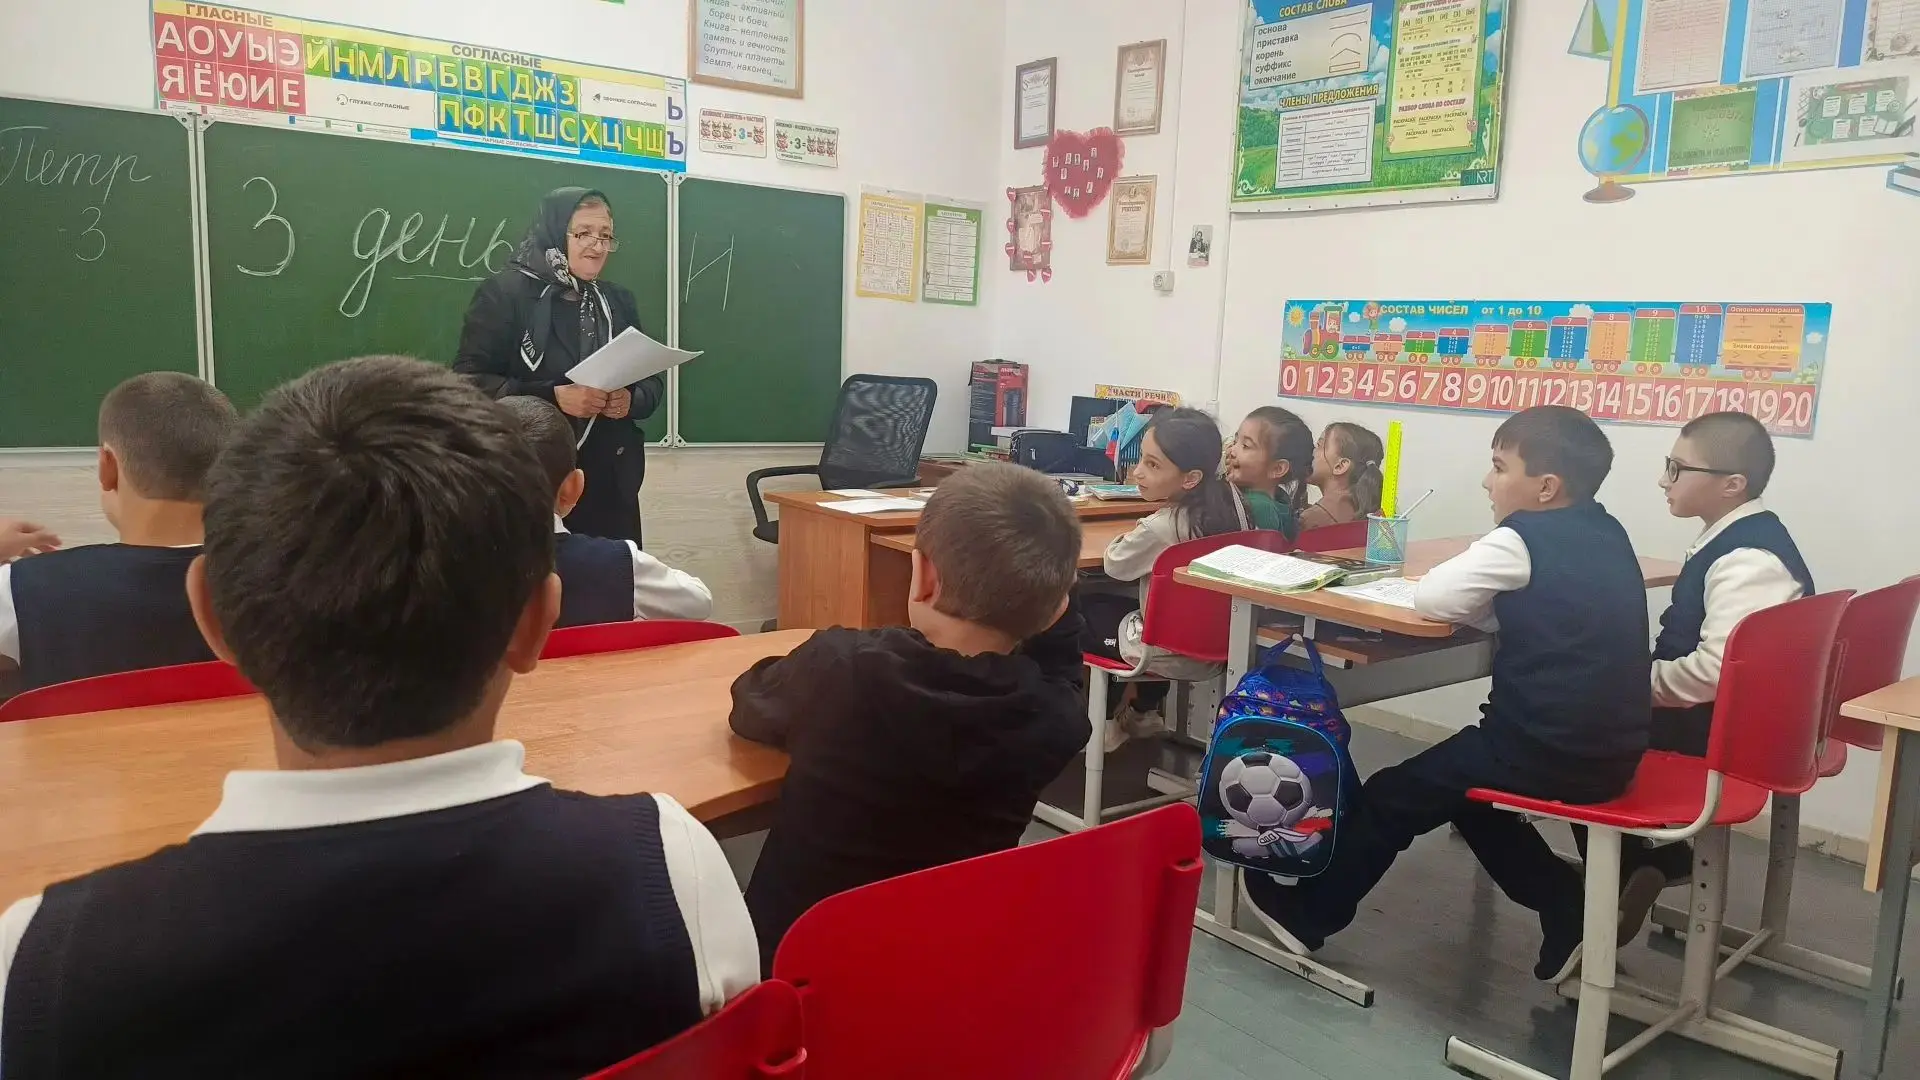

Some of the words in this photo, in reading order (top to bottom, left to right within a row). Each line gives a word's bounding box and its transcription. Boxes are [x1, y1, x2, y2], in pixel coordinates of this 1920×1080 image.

[185, 3, 273, 28] ГЛАСНЫЕ
[709, 8, 736, 21] борец
[741, 5, 785, 18] активный
[1279, 2, 1313, 18] СОСТАВ
[703, 19, 730, 32] Книга
[741, 28, 788, 43] нетленная
[1258, 24, 1288, 35] основа
[703, 33, 737, 45] память
[747, 41, 786, 54] вечность
[1256, 33, 1299, 50] приставка
[452, 44, 543, 69] СОГЛАСНЫЕ
[703, 44, 742, 58] Спутник
[745, 52, 785, 66] планеты
[1255, 50, 1284, 63] корень
[1255, 60, 1292, 75] суффикс
[1254, 73, 1297, 86] окончание
[1279, 94, 1309, 108] ЧЛЕНЫ
[1312, 83, 1379, 105] ПРЕДЛОЖЕНИЯ
[373, 101, 410, 111] СОГЛАСНЫЕ
[739, 127, 746, 140] 3
[794, 137, 801, 149] 3
[1380, 304, 1425, 315] СОСТАВ
[1428, 304, 1469, 316] ЧИСЕЛ
[1481, 306, 1494, 315] от
[1498, 305, 1504, 314] 1
[1508, 307, 1523, 316] до
[1527, 305, 1542, 315] 10
[1112, 388, 1141, 398] ЧАСТИ
[1144, 392, 1166, 401] РЕЧИ
[1283, 365, 1297, 391] 0
[1304, 366, 1315, 392] 1
[1318, 367, 1335, 393] 2
[1337, 368, 1353, 395] 3
[1356, 370, 1375, 396] 4
[1377, 370, 1396, 397] 5
[1398, 371, 1417, 399] 6
[1421, 372, 1440, 400] 7
[1442, 373, 1462, 402] 8
[1467, 374, 1487, 403] 9
[1489, 375, 1513, 405] 10
[1516, 377, 1540, 407] 11
[1542, 378, 1566, 406] 12
[1569, 380, 1593, 412] 13
[1597, 382, 1621, 414] 14
[1625, 383, 1652, 416] 15
[1654, 384, 1682, 418] 16
[1685, 387, 1715, 417] 17
[1717, 388, 1744, 412] 18
[1749, 390, 1778, 424] 19
[1779, 391, 1812, 427] 20
